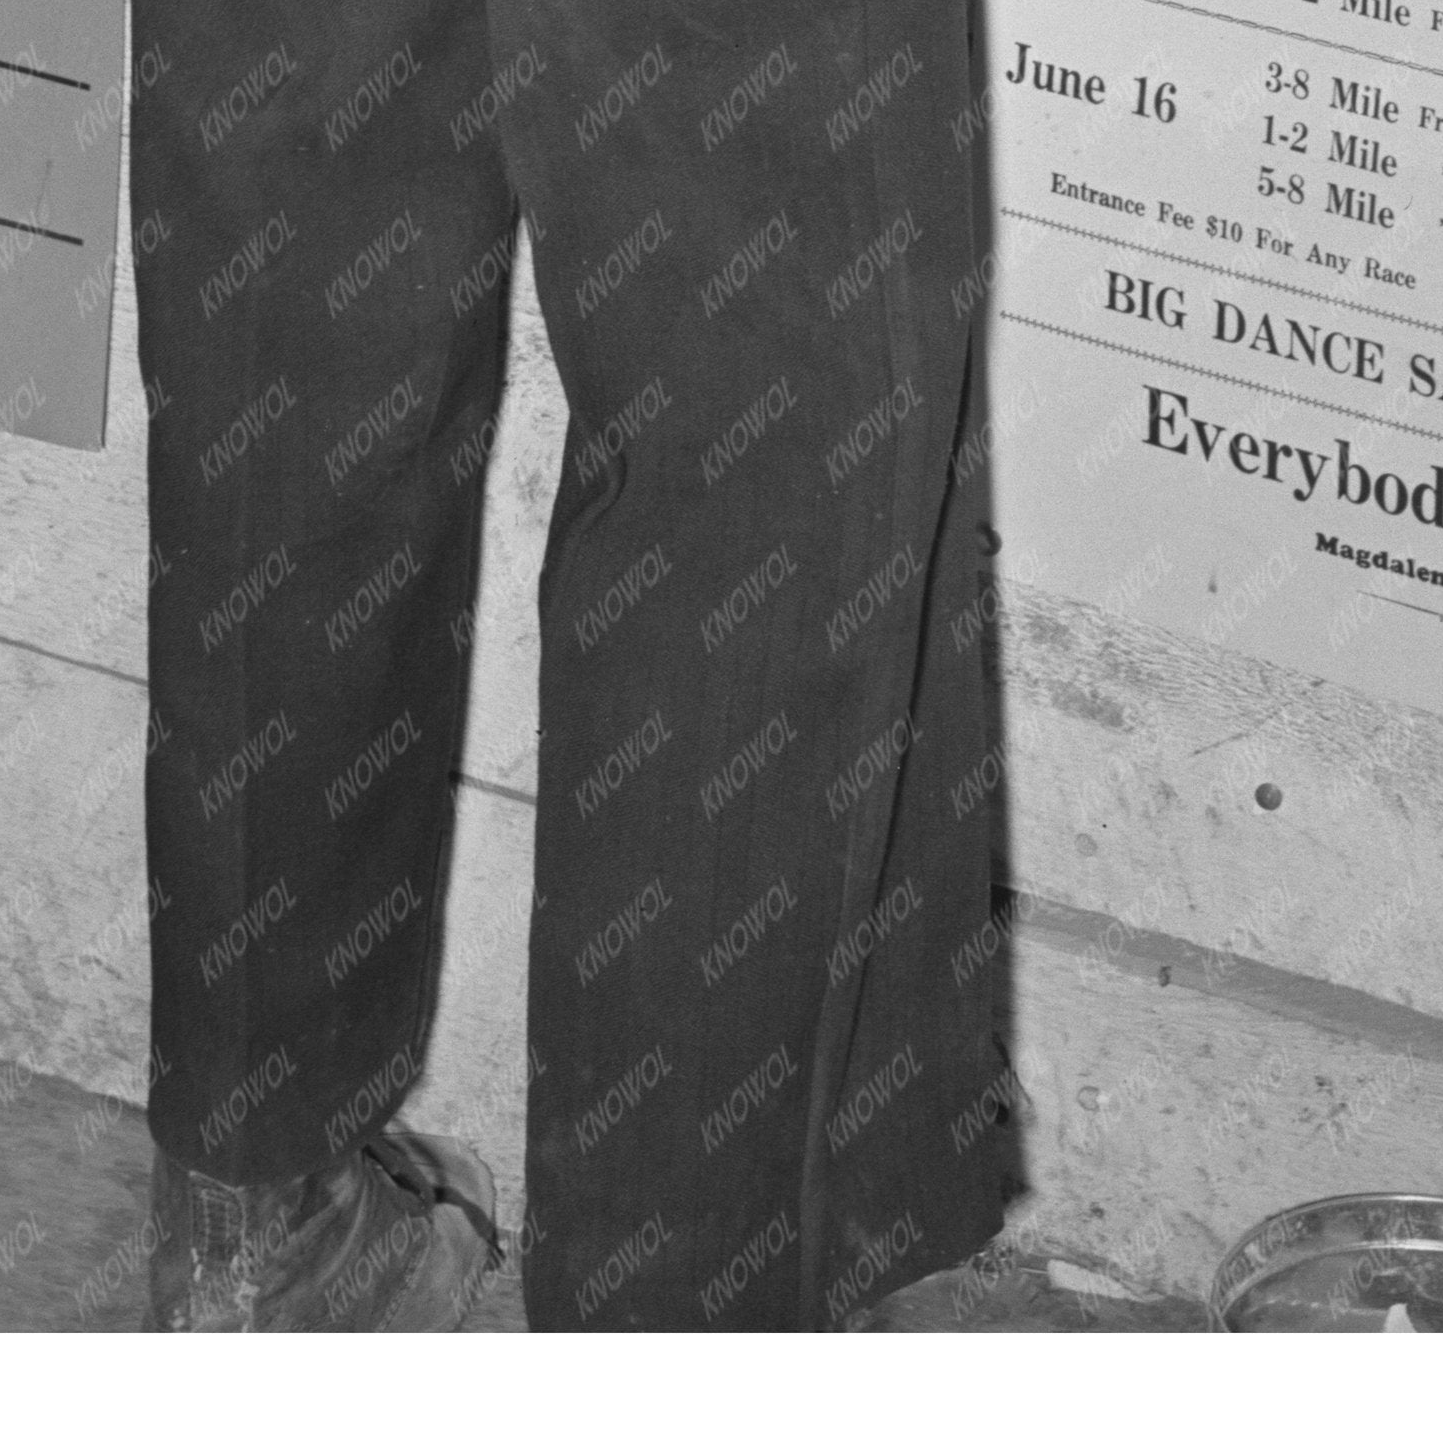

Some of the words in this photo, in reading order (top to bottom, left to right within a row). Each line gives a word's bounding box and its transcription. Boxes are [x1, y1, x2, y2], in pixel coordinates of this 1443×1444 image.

[1005, 40, 1107, 107] June
[1130, 75, 1179, 125] 16
[1103, 269, 1187, 331] BIG
[1212, 298, 1385, 385] DANCE
